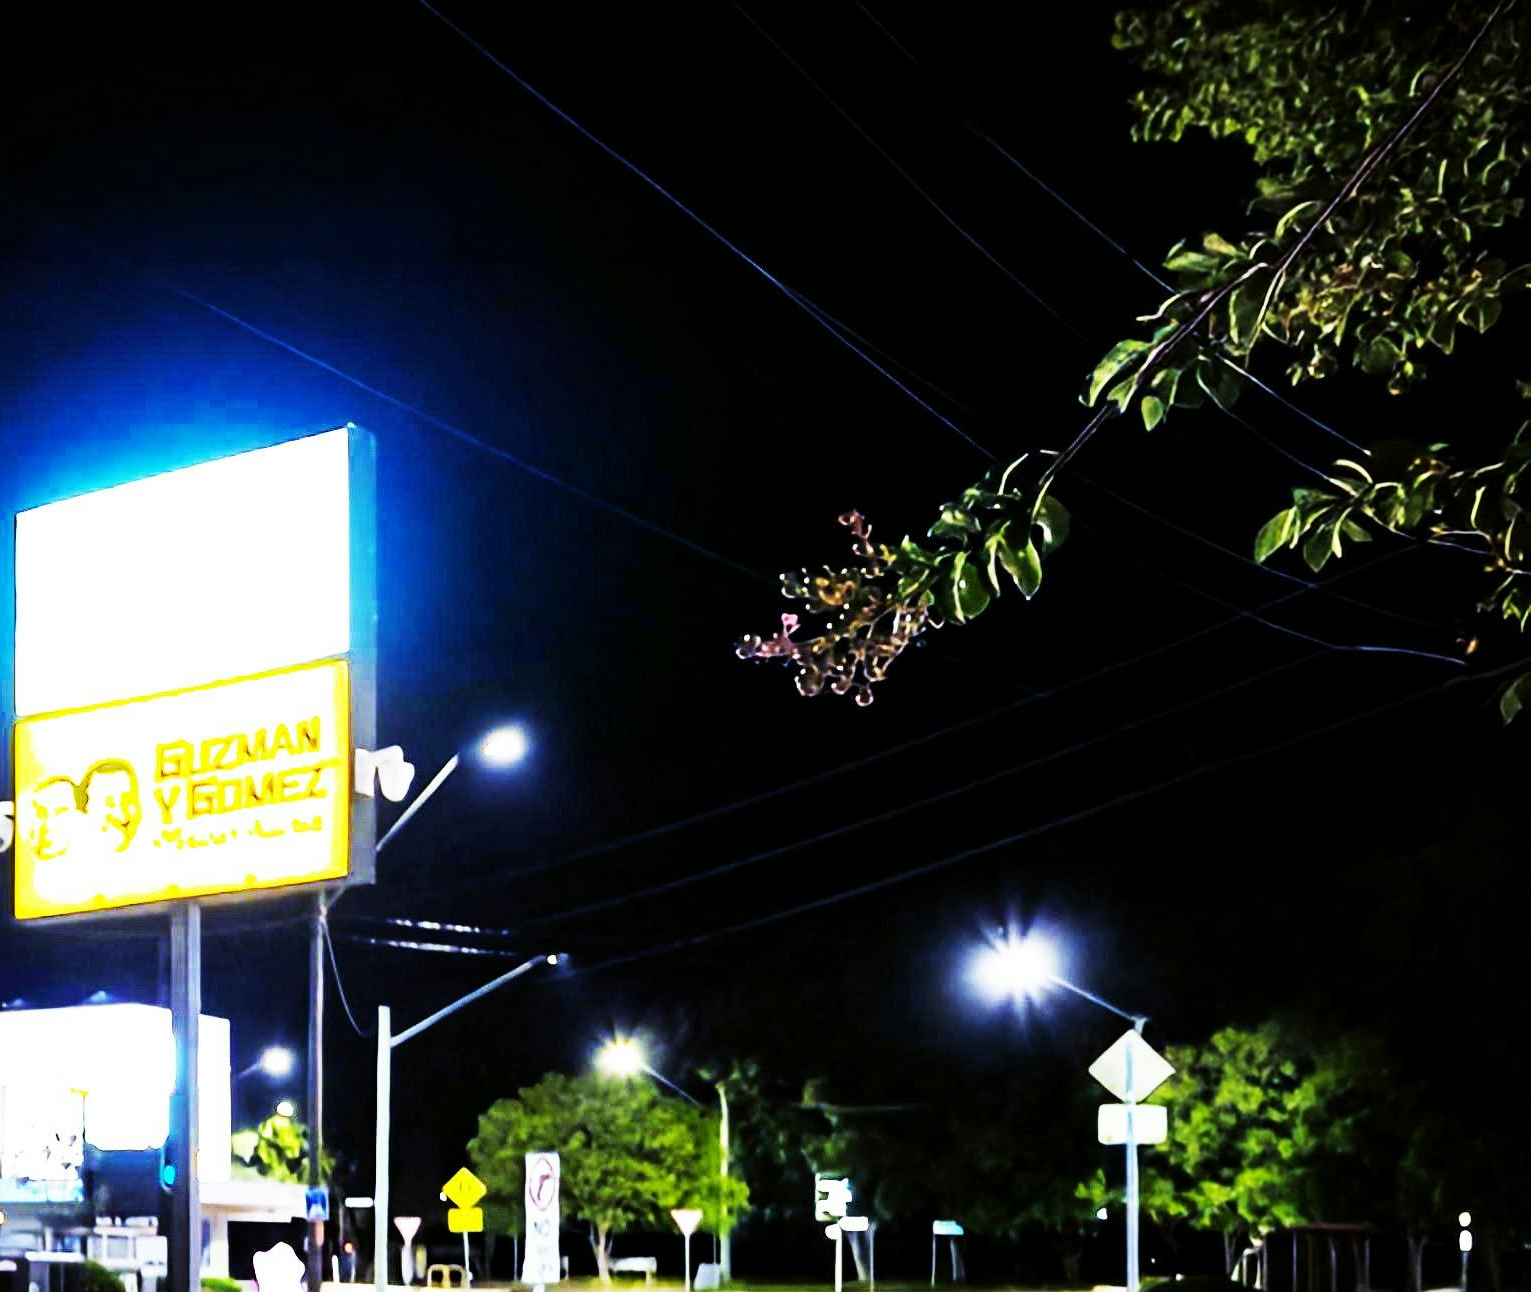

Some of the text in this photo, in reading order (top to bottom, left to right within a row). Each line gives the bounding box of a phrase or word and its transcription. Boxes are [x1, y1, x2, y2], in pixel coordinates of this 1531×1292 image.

[155, 716, 321, 782] GUZMAN
[153, 767, 328, 825] Y GOMEZ
